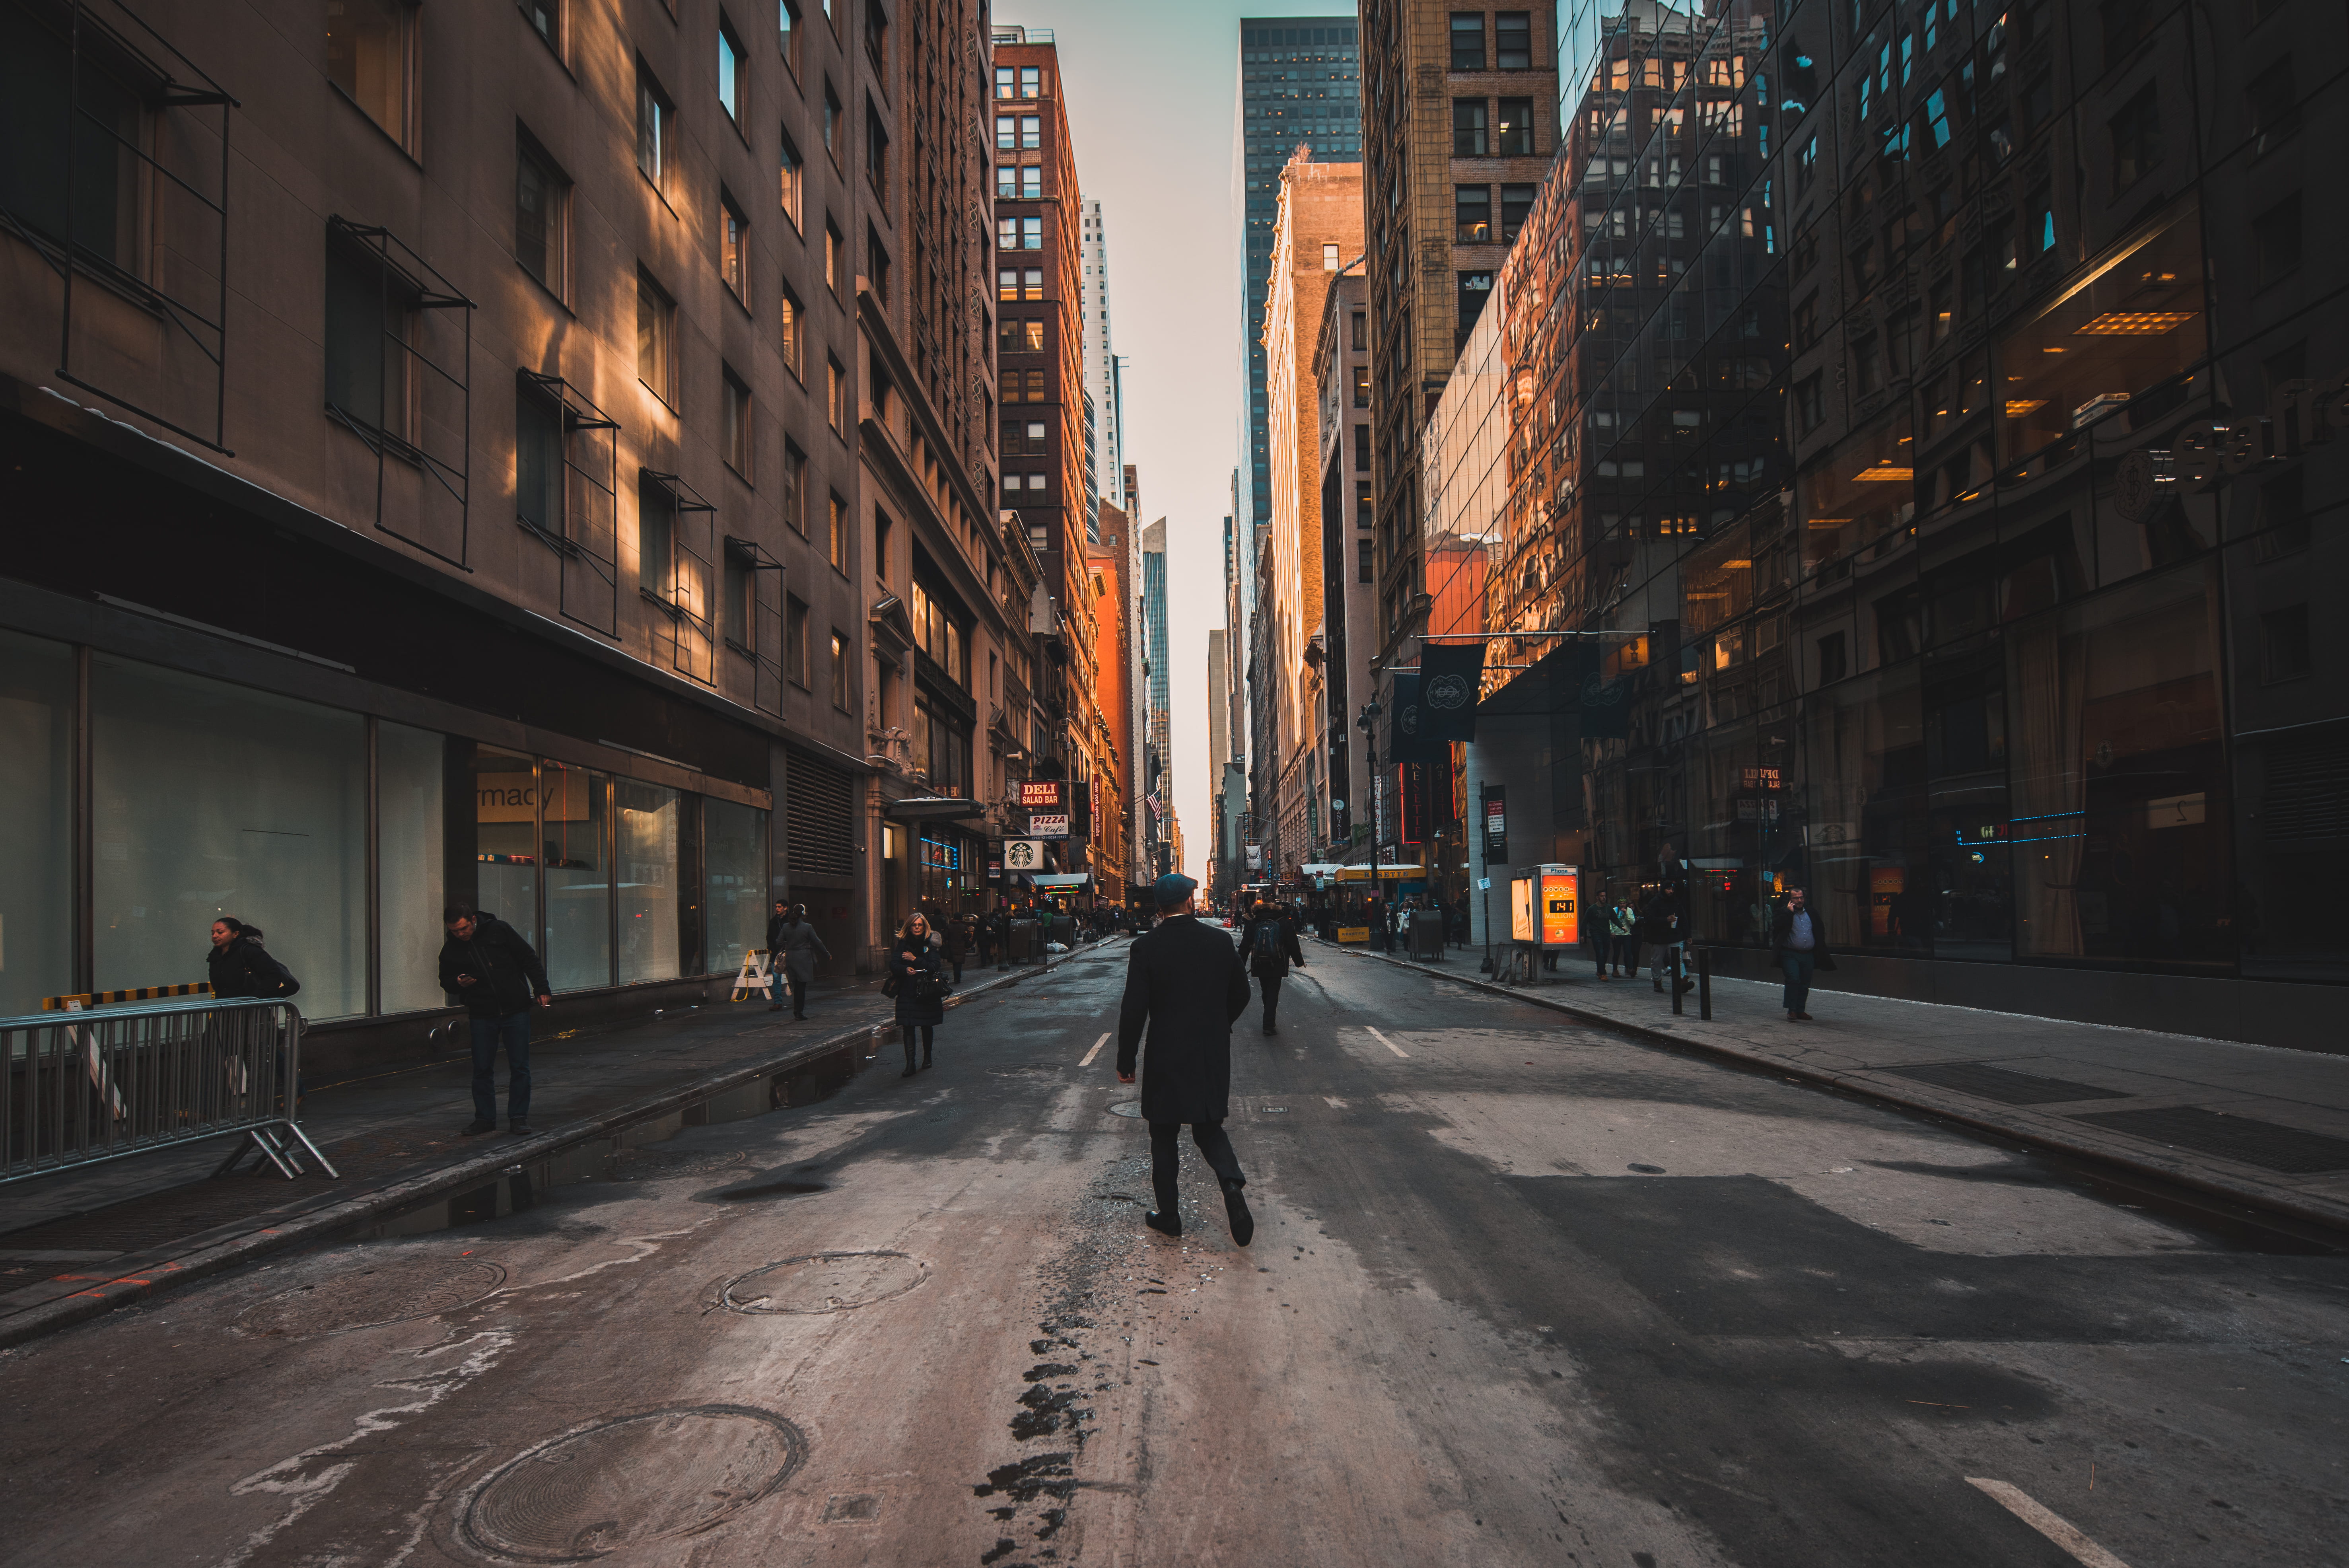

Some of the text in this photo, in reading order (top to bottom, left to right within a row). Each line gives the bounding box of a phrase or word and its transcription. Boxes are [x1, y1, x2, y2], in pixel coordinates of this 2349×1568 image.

[1024, 784, 1055, 794] DELI
[1033, 816, 1065, 824] PIZZA
[1044, 825, 1065, 834] Café
[1557, 902, 1572, 911] 141
